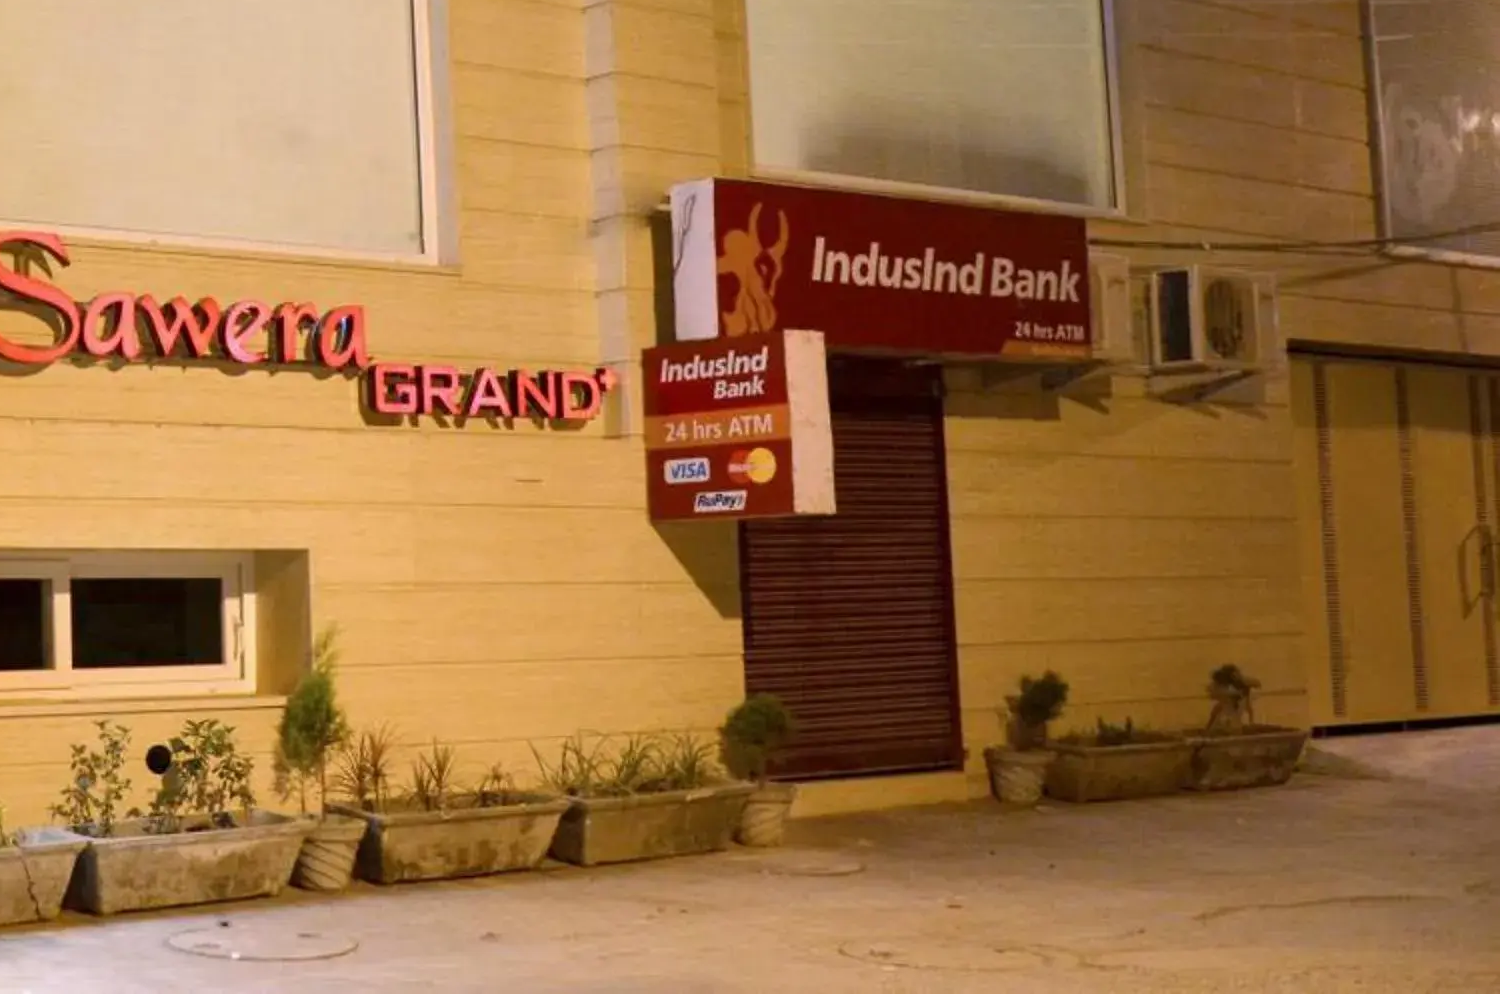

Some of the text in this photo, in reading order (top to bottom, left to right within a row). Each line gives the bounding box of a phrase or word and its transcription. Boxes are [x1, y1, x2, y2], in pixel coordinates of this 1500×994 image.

[811, 235, 1082, 303] IndusInd Bank
[1014, 320, 1085, 342] 24 hrs ATM
[659, 346, 769, 383] IndusInd
[374, 364, 602, 420] GRAND
[713, 376, 766, 400] Bank
[665, 413, 774, 443] 24 hrs ATM
[671, 462, 707, 479] VISA
